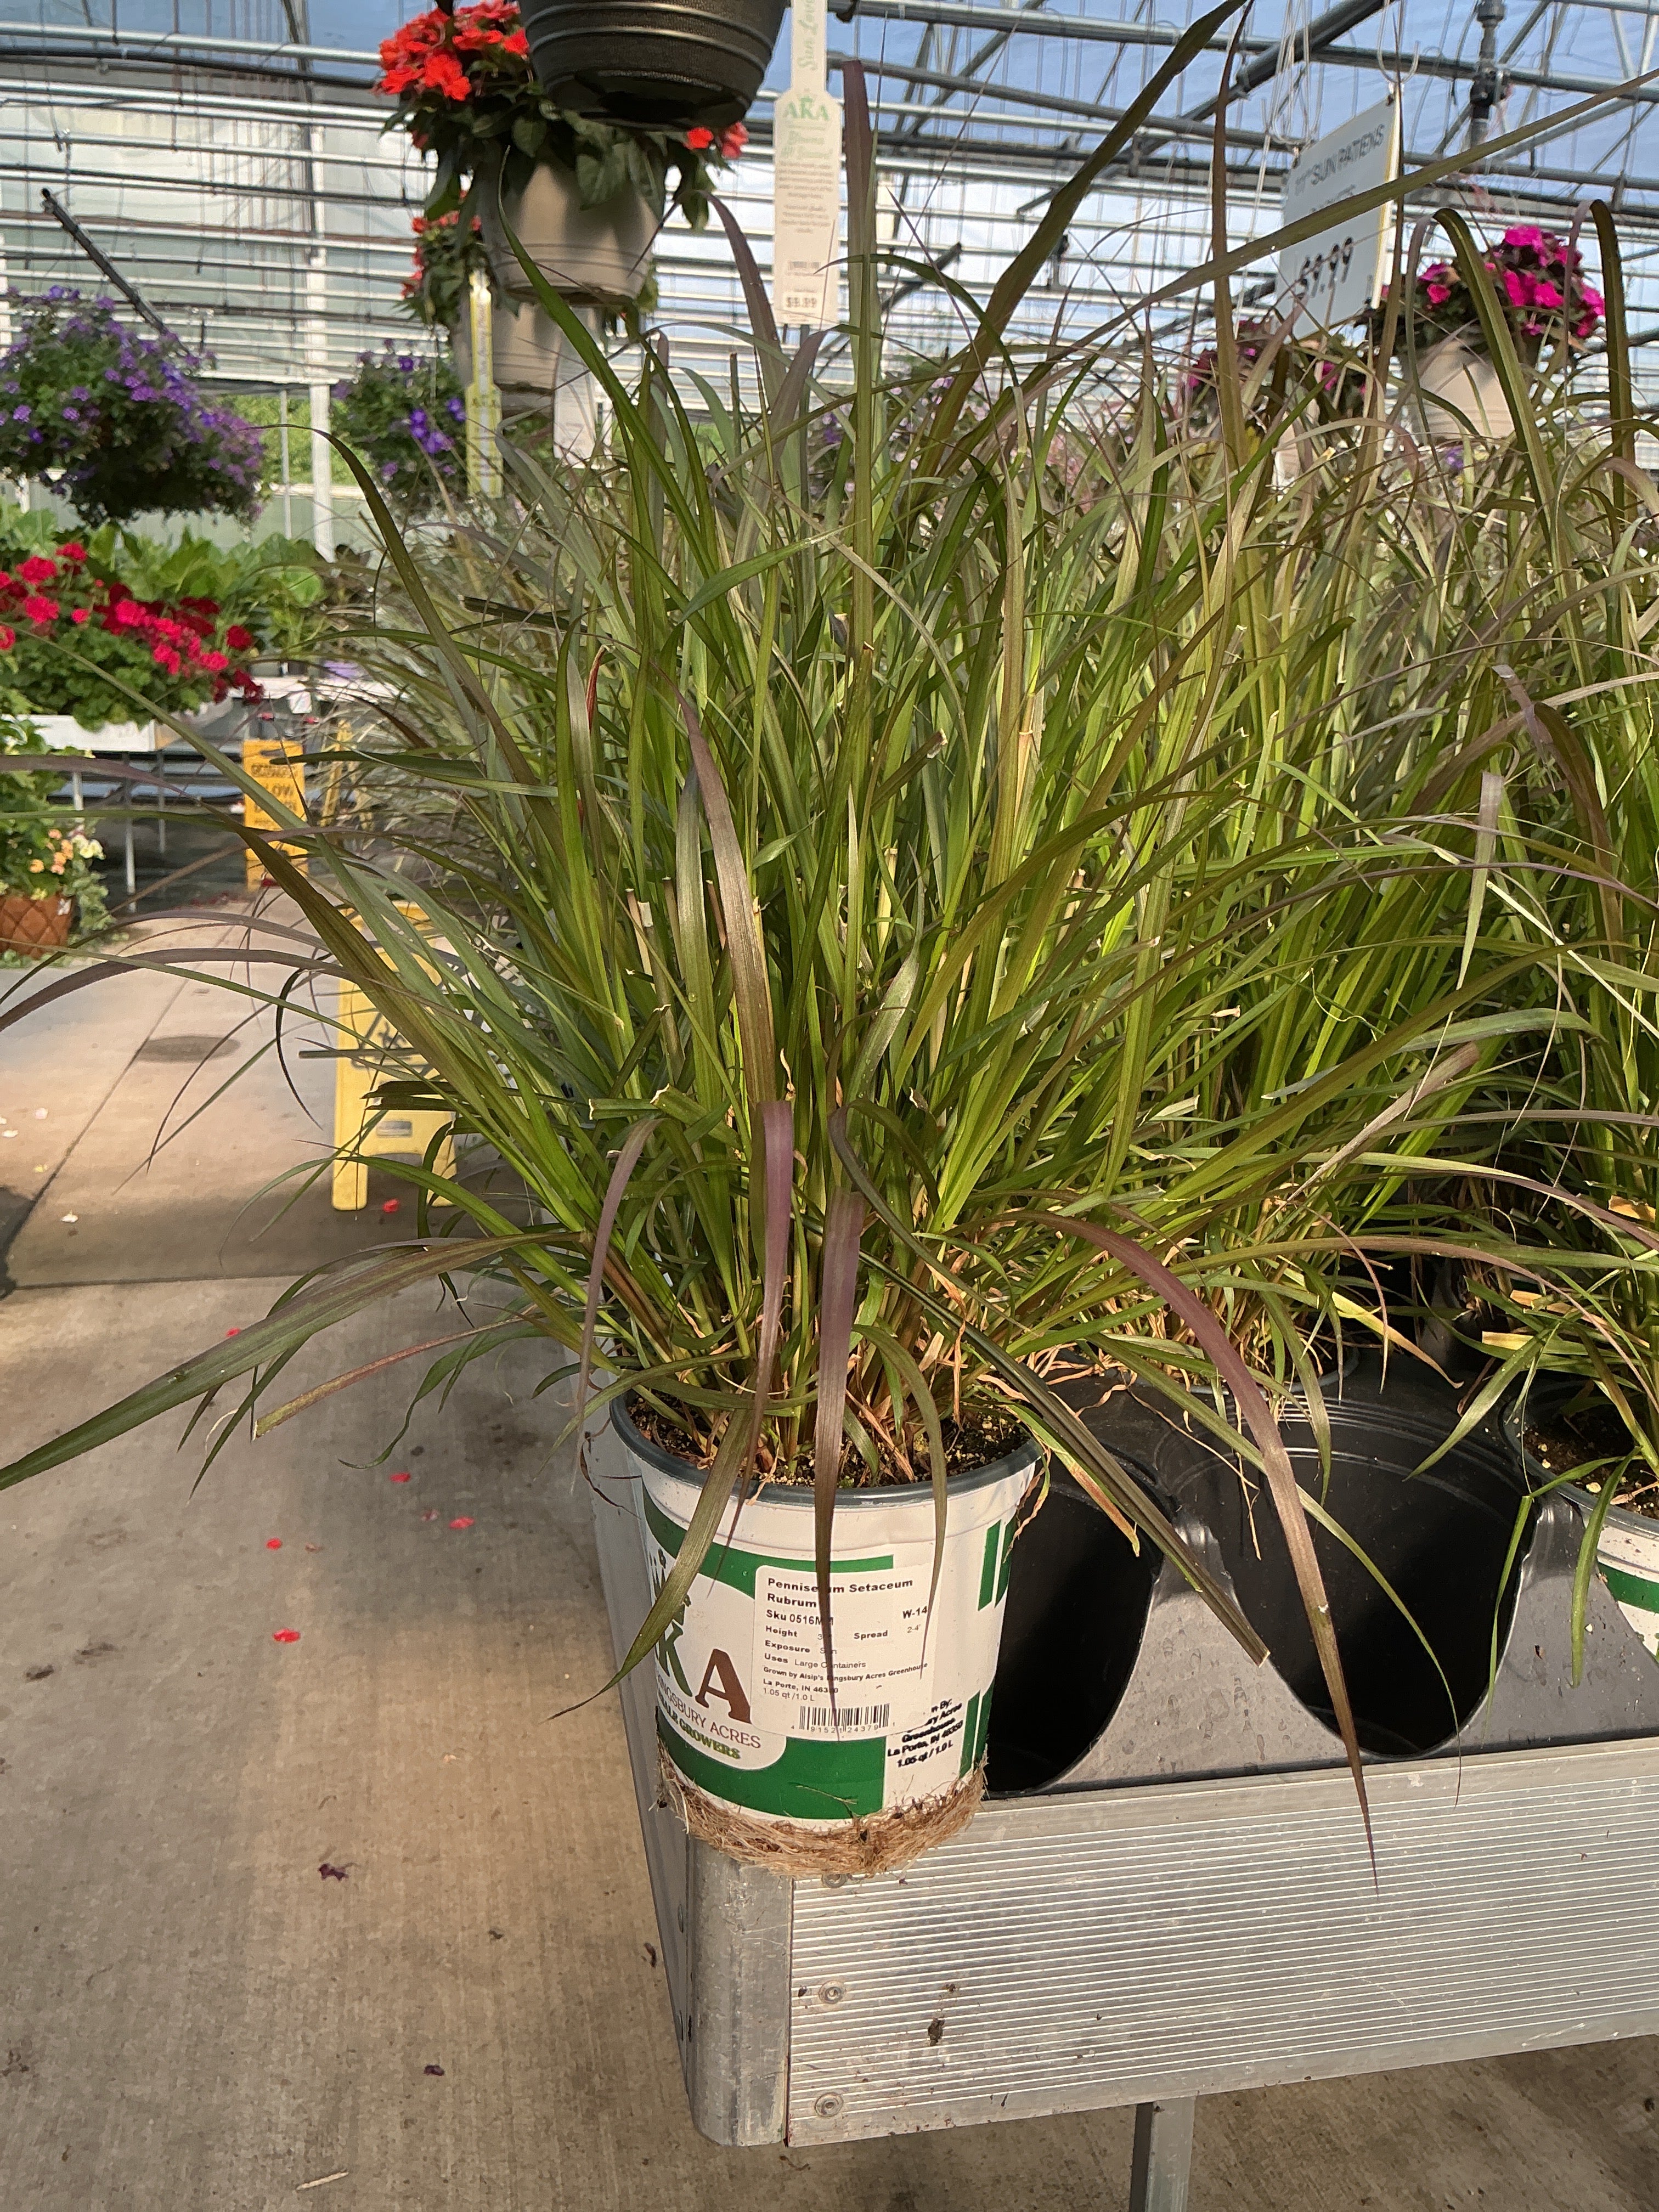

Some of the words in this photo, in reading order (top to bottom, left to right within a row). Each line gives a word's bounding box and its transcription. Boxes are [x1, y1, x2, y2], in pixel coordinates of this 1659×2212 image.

[768, 1577, 845, 1593] Pennisem
[849, 1579, 913, 1593] Setaceum
[767, 1593, 817, 1608] Rubrum
[766, 1609, 787, 1621] Sku
[902, 1606, 928, 1620] W-14
[765, 1625, 798, 1637] Height
[854, 1630, 888, 1640] Spread
[765, 1639, 810, 1653] Exposure
[764, 1652, 788, 1663] Uses
[795, 1659, 819, 1669] Large
[821, 1661, 866, 1669] Cntainers
[763, 1666, 787, 1677] Grown
[789, 1671, 798, 1679] by
[763, 1688, 780, 1696] 1.05
[775, 1681, 799, 1691] Porte,
[710, 1722, 761, 1749] ACRES
[887, 1748, 901, 1757] La
